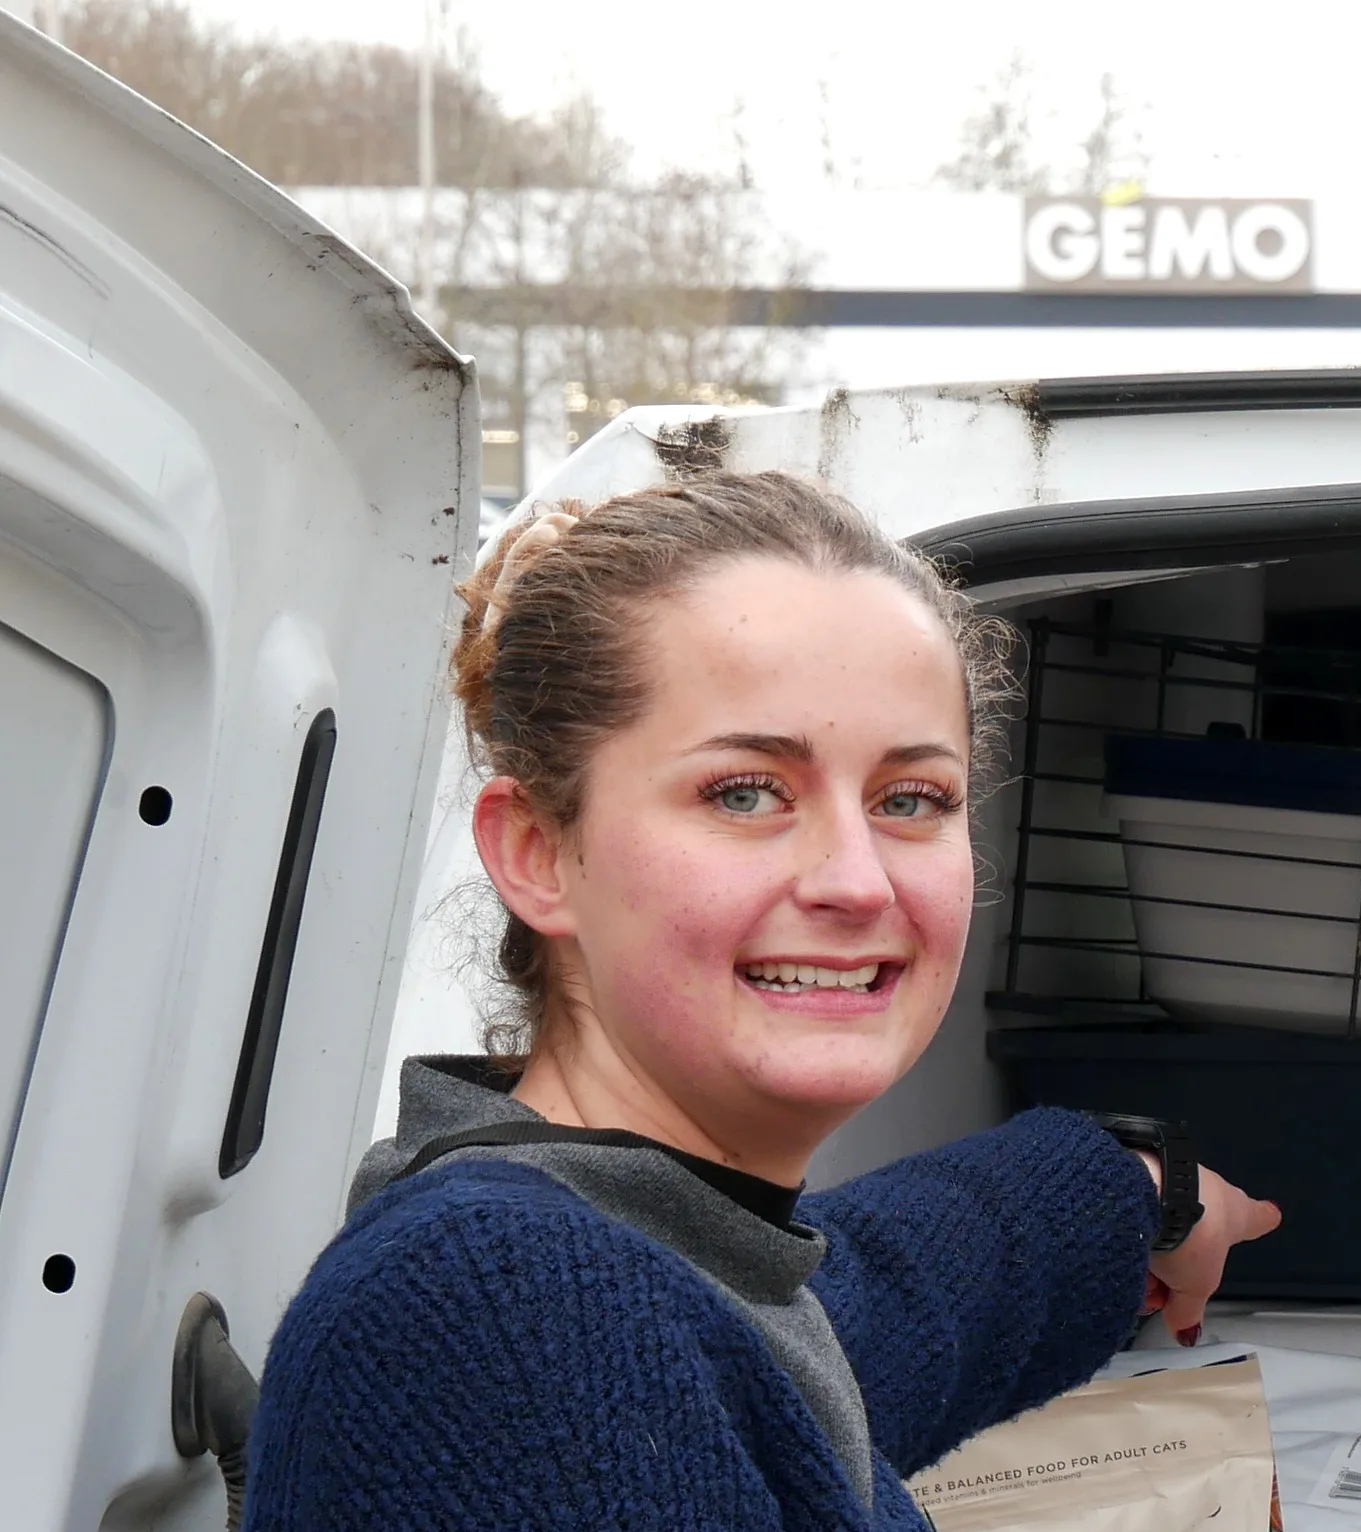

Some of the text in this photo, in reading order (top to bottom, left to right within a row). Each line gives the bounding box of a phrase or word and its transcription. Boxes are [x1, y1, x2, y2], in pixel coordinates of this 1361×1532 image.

[934, 1440, 1188, 1493] & BALANCED FOOD FOR ADULT CATS
[944, 1488, 979, 1503] vitamins
[989, 1481, 1025, 1494] minerals
[1026, 1478, 1039, 1487] for
[1041, 1471, 1082, 1485] wellbeing
